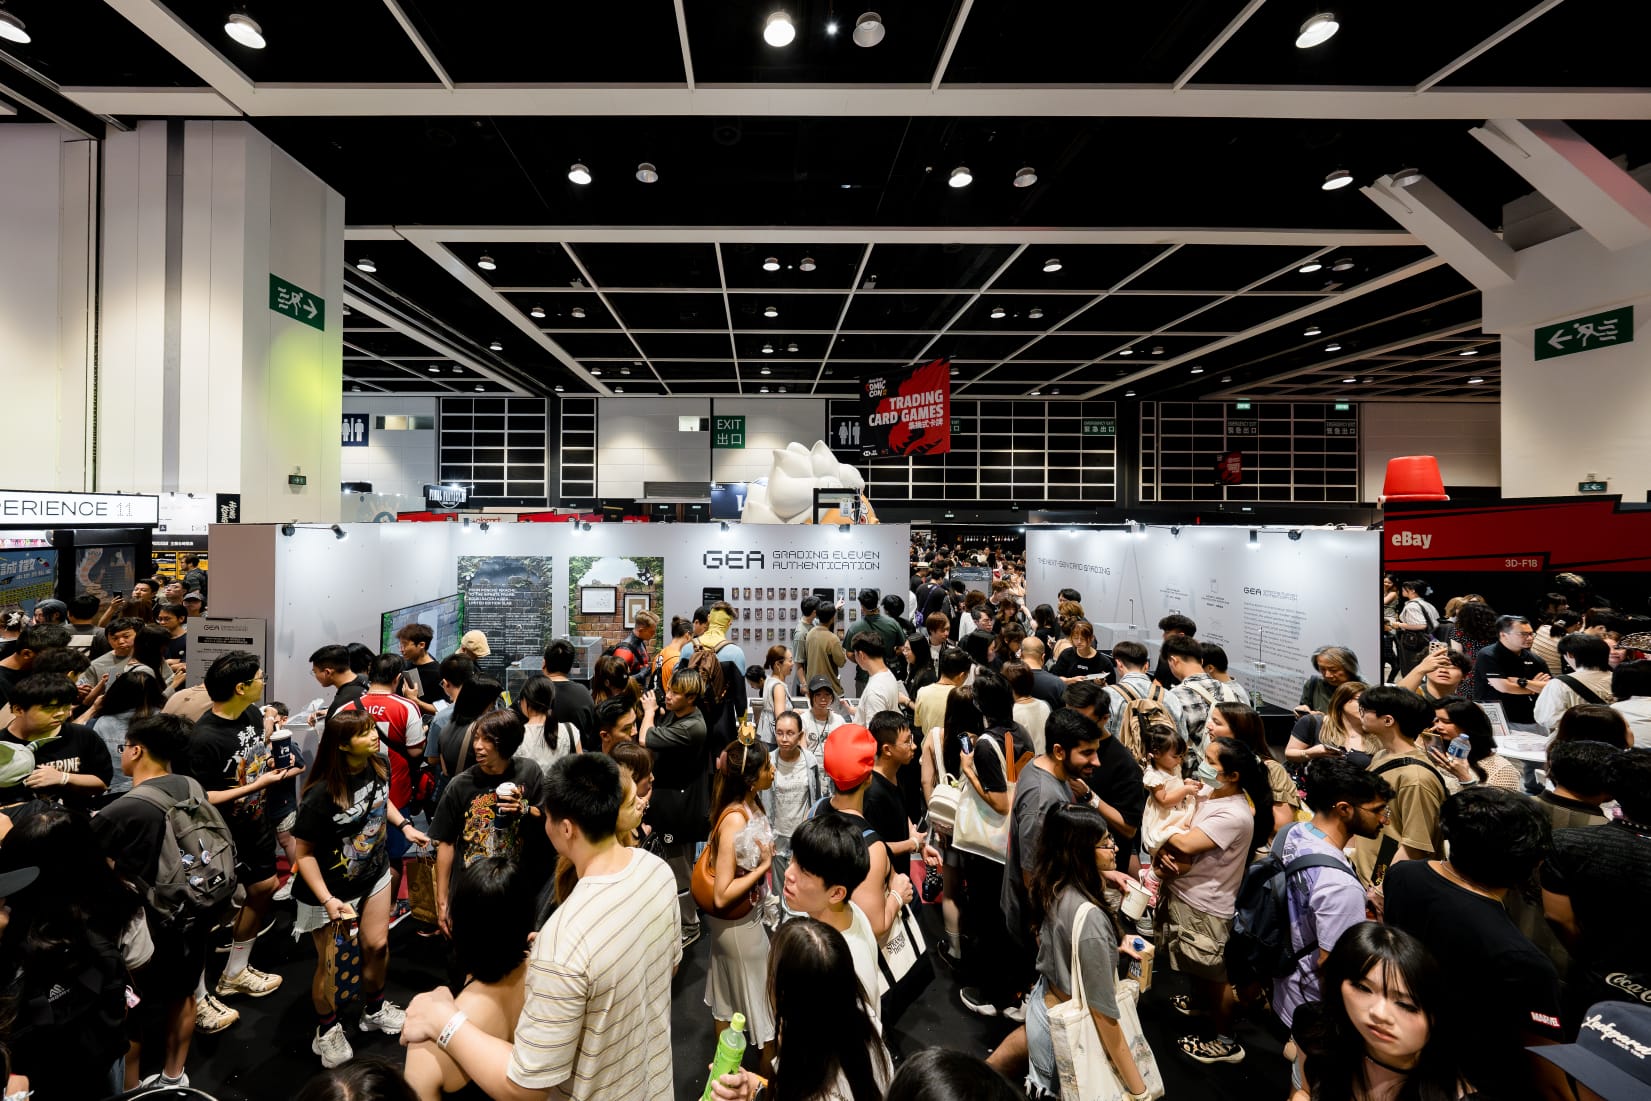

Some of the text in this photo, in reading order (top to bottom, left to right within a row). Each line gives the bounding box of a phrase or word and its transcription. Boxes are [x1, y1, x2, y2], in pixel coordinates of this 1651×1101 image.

[889, 389, 943, 410] TRADING
[868, 403, 943, 427] CARD GAMES
[717, 419, 741, 430] EXIT
[717, 433, 742, 445] 出口
[0, 500, 133, 517] ERIENCE 11
[1391, 531, 1432, 549] eBay
[703, 550, 765, 570] GEA
[772, 550, 880, 560] GRADING ELEVEN
[772, 561, 880, 570] AUTHENTICATION
[1243, 587, 1262, 596] GEA
[365, 704, 386, 716] ICE
[1530, 1011, 1560, 1028] MARVEL
